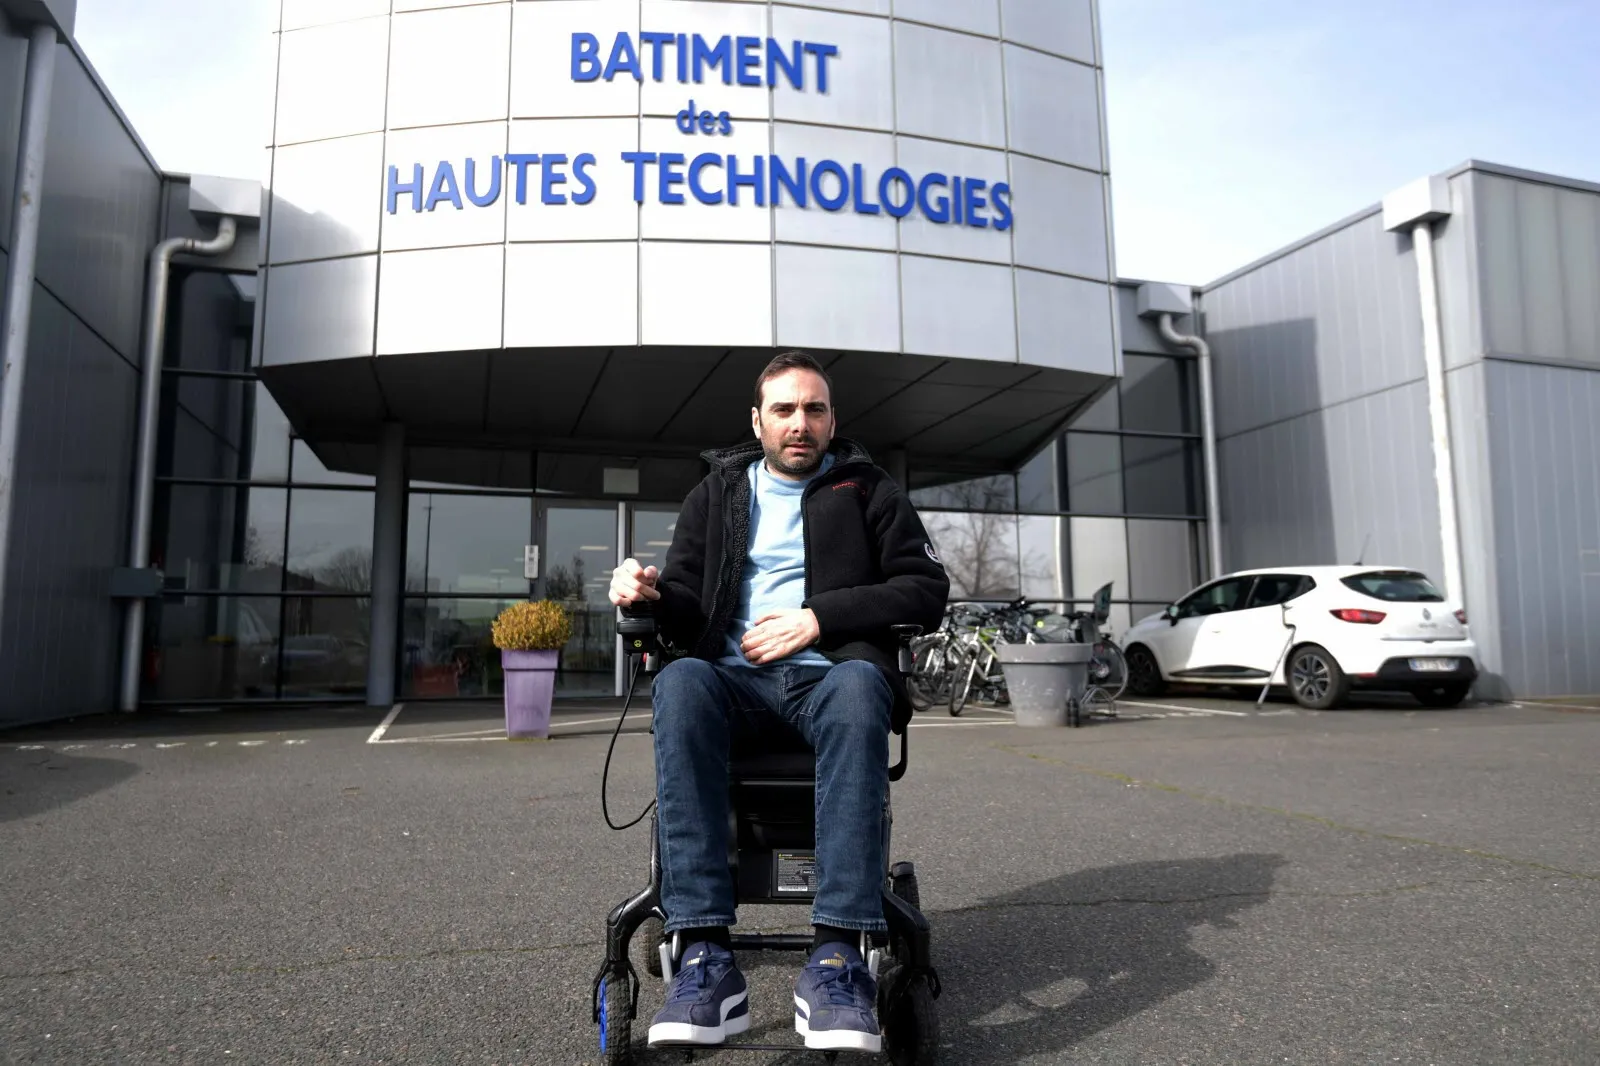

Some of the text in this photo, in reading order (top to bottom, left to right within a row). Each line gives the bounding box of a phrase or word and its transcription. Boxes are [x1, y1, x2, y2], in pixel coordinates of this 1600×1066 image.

[571, 31, 838, 93] BATIMENT
[677, 100, 731, 135] des
[387, 152, 1013, 231] HAUTES TECHNOLOGIES
